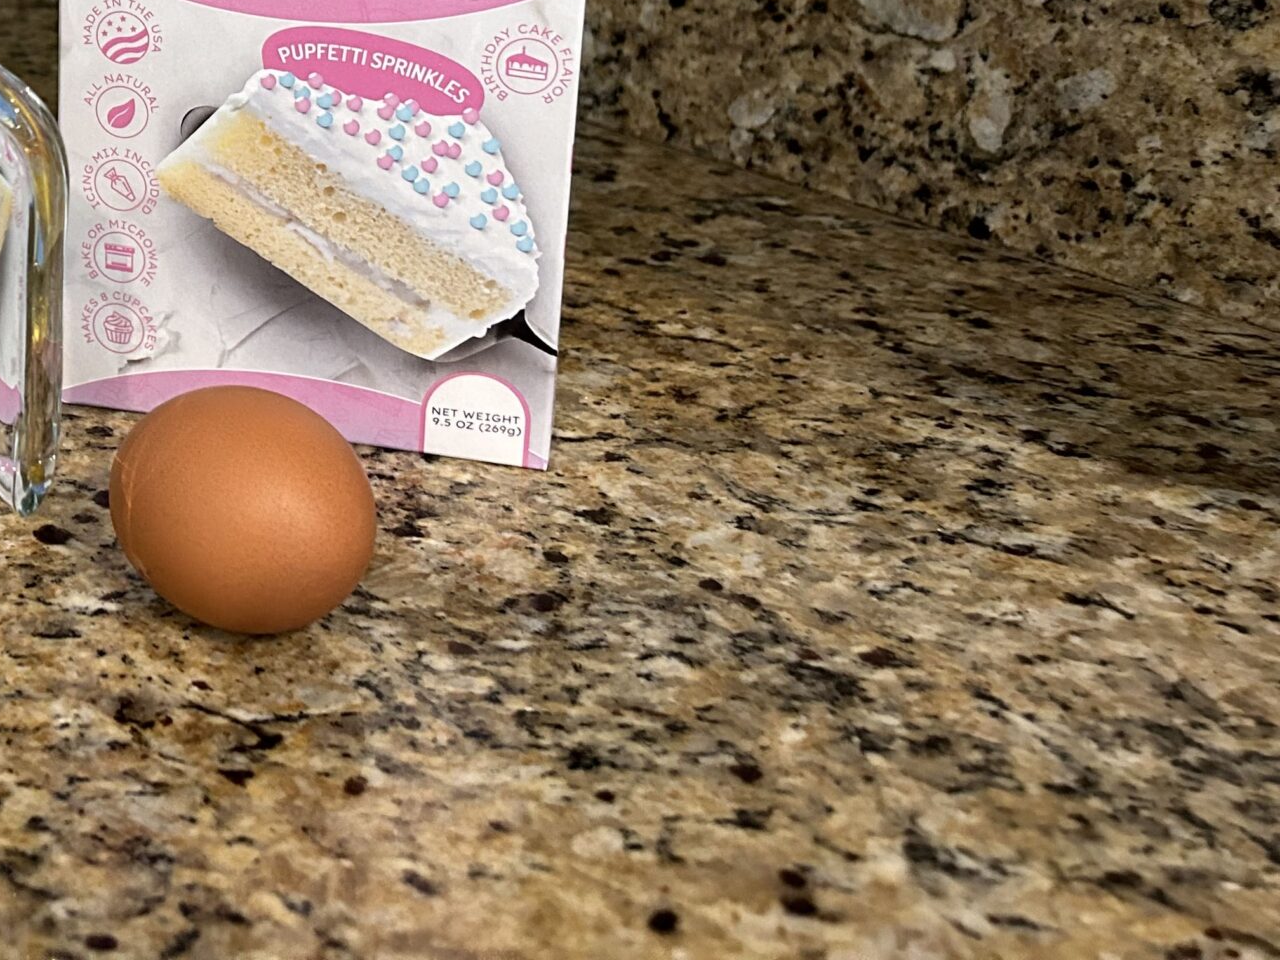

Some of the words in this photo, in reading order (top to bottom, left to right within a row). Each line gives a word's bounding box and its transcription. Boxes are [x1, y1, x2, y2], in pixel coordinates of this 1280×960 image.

[82, 6, 102, 45] MADE
[151, 24, 163, 53] USA
[277, 42, 368, 66] PUPFETTI
[370, 51, 471, 105] SPRINKLES
[481, 27, 511, 101] BIRTHDAY
[518, 24, 563, 46] CAKE
[541, 47, 574, 104] FLAVOR
[83, 83, 102, 106] ALL
[104, 73, 159, 113] NATURAL
[82, 164, 101, 210] ICING
[92, 147, 119, 164] MIX
[124, 148, 160, 215] INCLUDED
[88, 223, 104, 239] OR
[109, 219, 158, 288] MICROWAVE
[81, 241, 99, 280] BAKE
[81, 298, 99, 344] MAKES
[100, 292, 108, 302] 8
[112, 291, 157, 351] CUPCAKES
[432, 406, 458, 417] NET
[463, 410, 520, 425] WEIGHT
[432, 417, 451, 427] 9.5
[456, 420, 474, 430] OZ
[478, 423, 522, 437] (269g)
